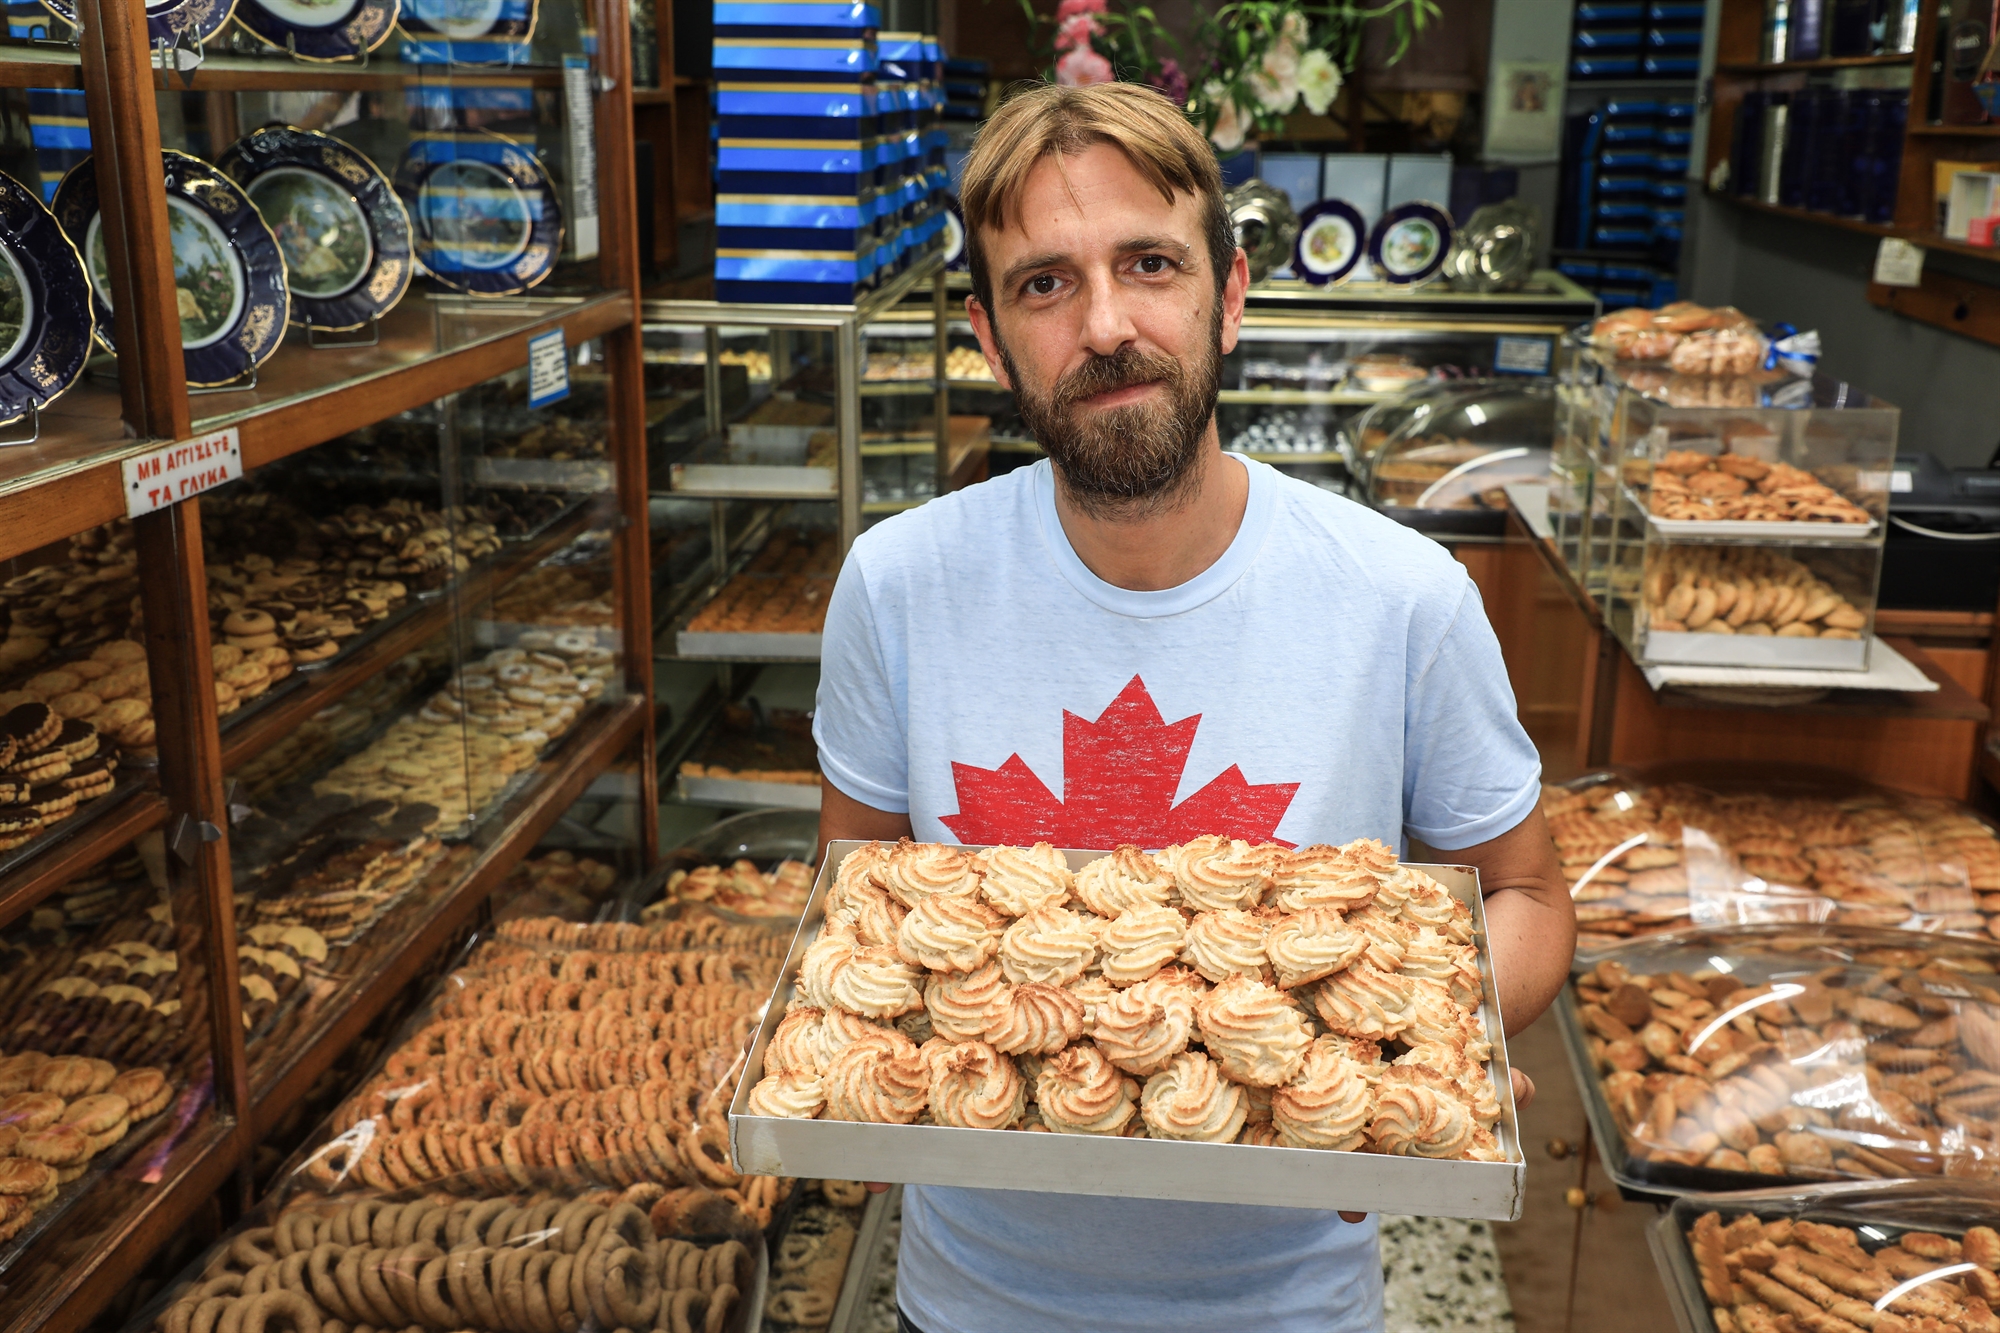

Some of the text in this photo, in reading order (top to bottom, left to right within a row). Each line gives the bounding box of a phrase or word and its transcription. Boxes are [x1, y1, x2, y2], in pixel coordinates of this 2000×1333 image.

[137, 457, 160, 481] ΜΗ
[148, 465, 228, 508] ΤΑ ΓΛΥΚΑ
